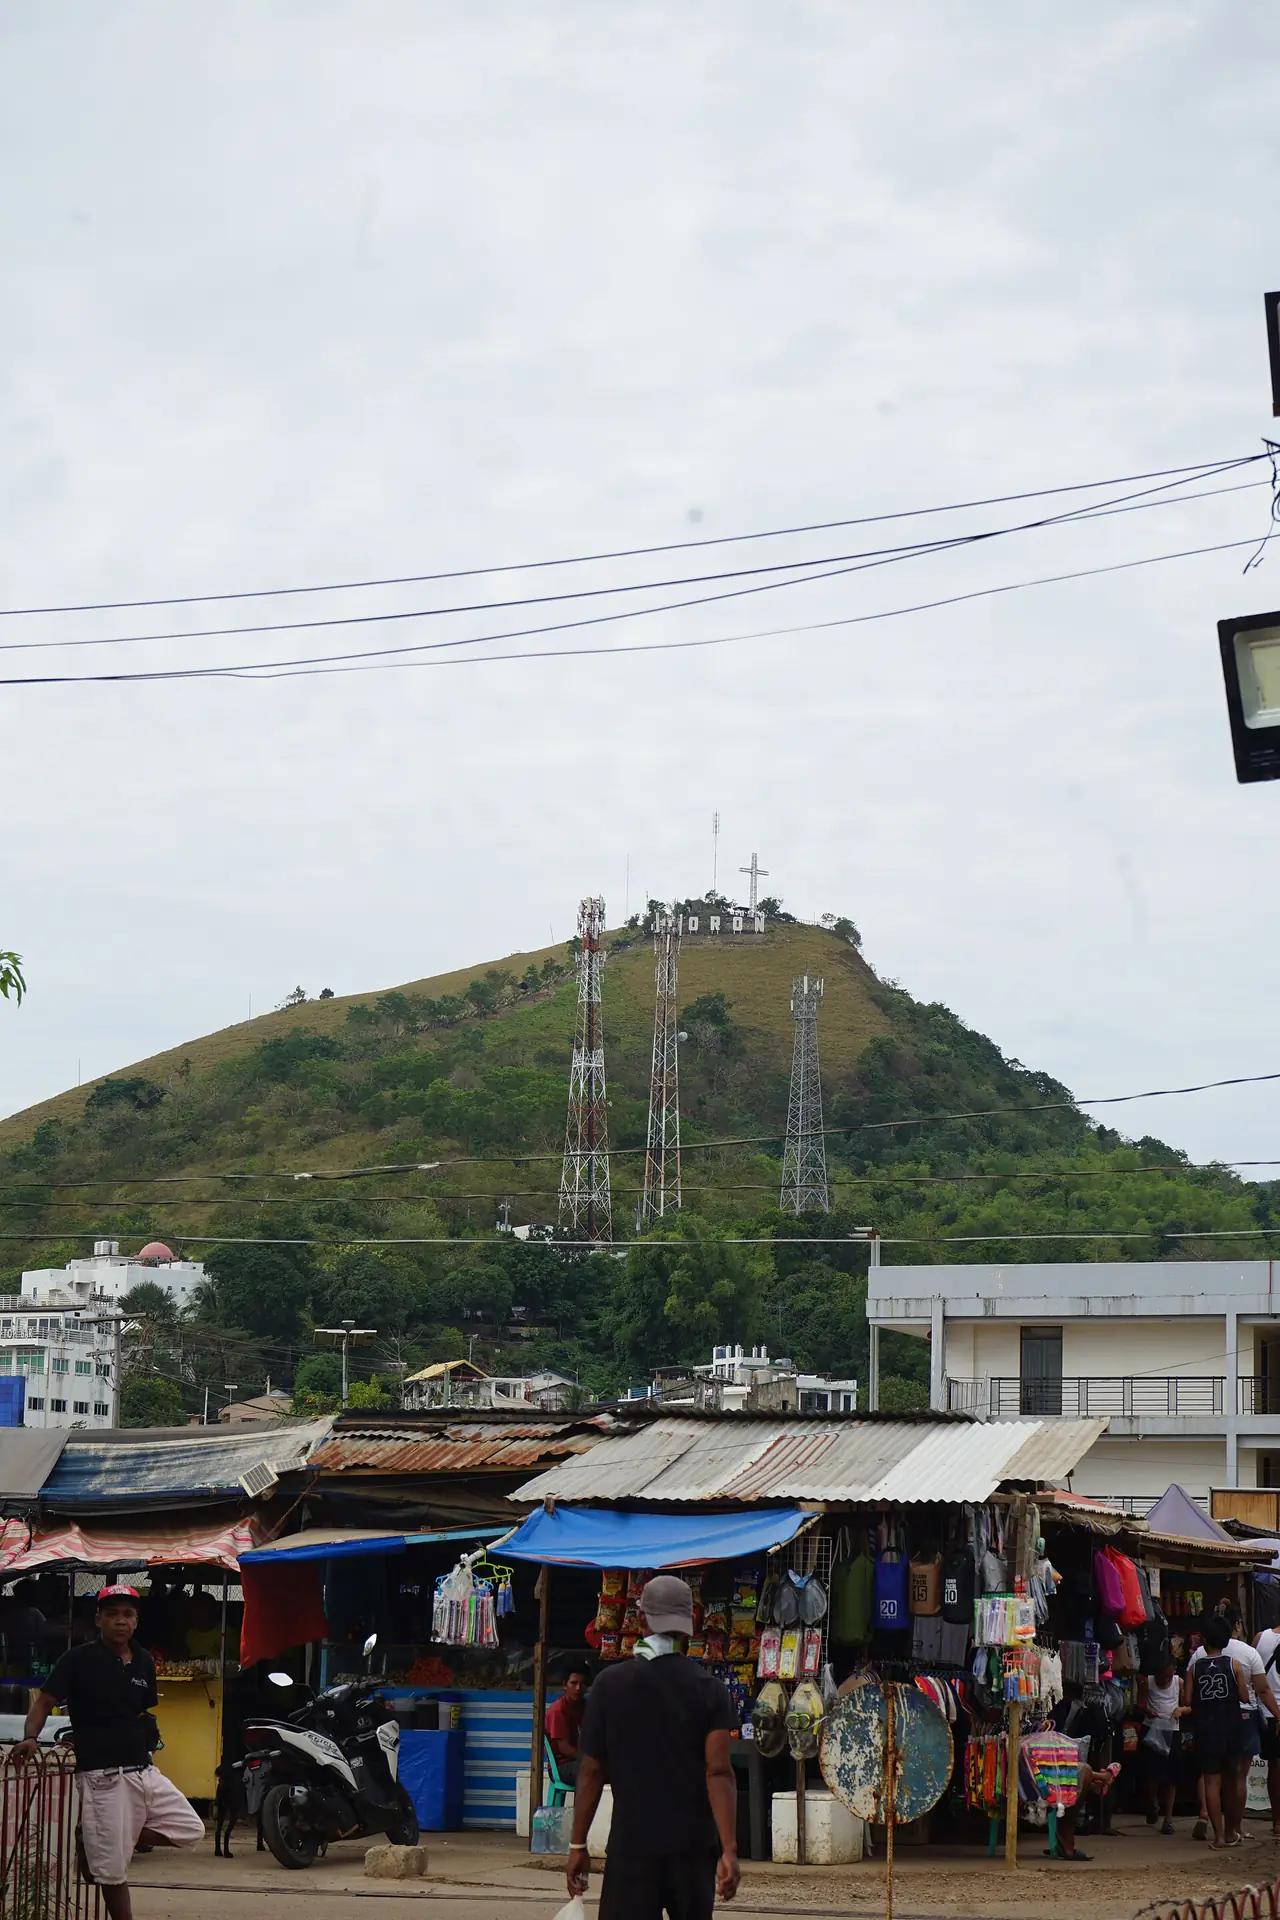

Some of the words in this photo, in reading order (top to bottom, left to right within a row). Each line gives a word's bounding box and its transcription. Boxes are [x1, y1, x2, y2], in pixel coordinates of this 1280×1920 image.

[667, 916, 765, 933] ORON
[914, 1587, 927, 1601] 15
[945, 1590, 957, 1603] 10
[881, 1601, 897, 1615] 20
[1199, 1673, 1229, 1700] 23
